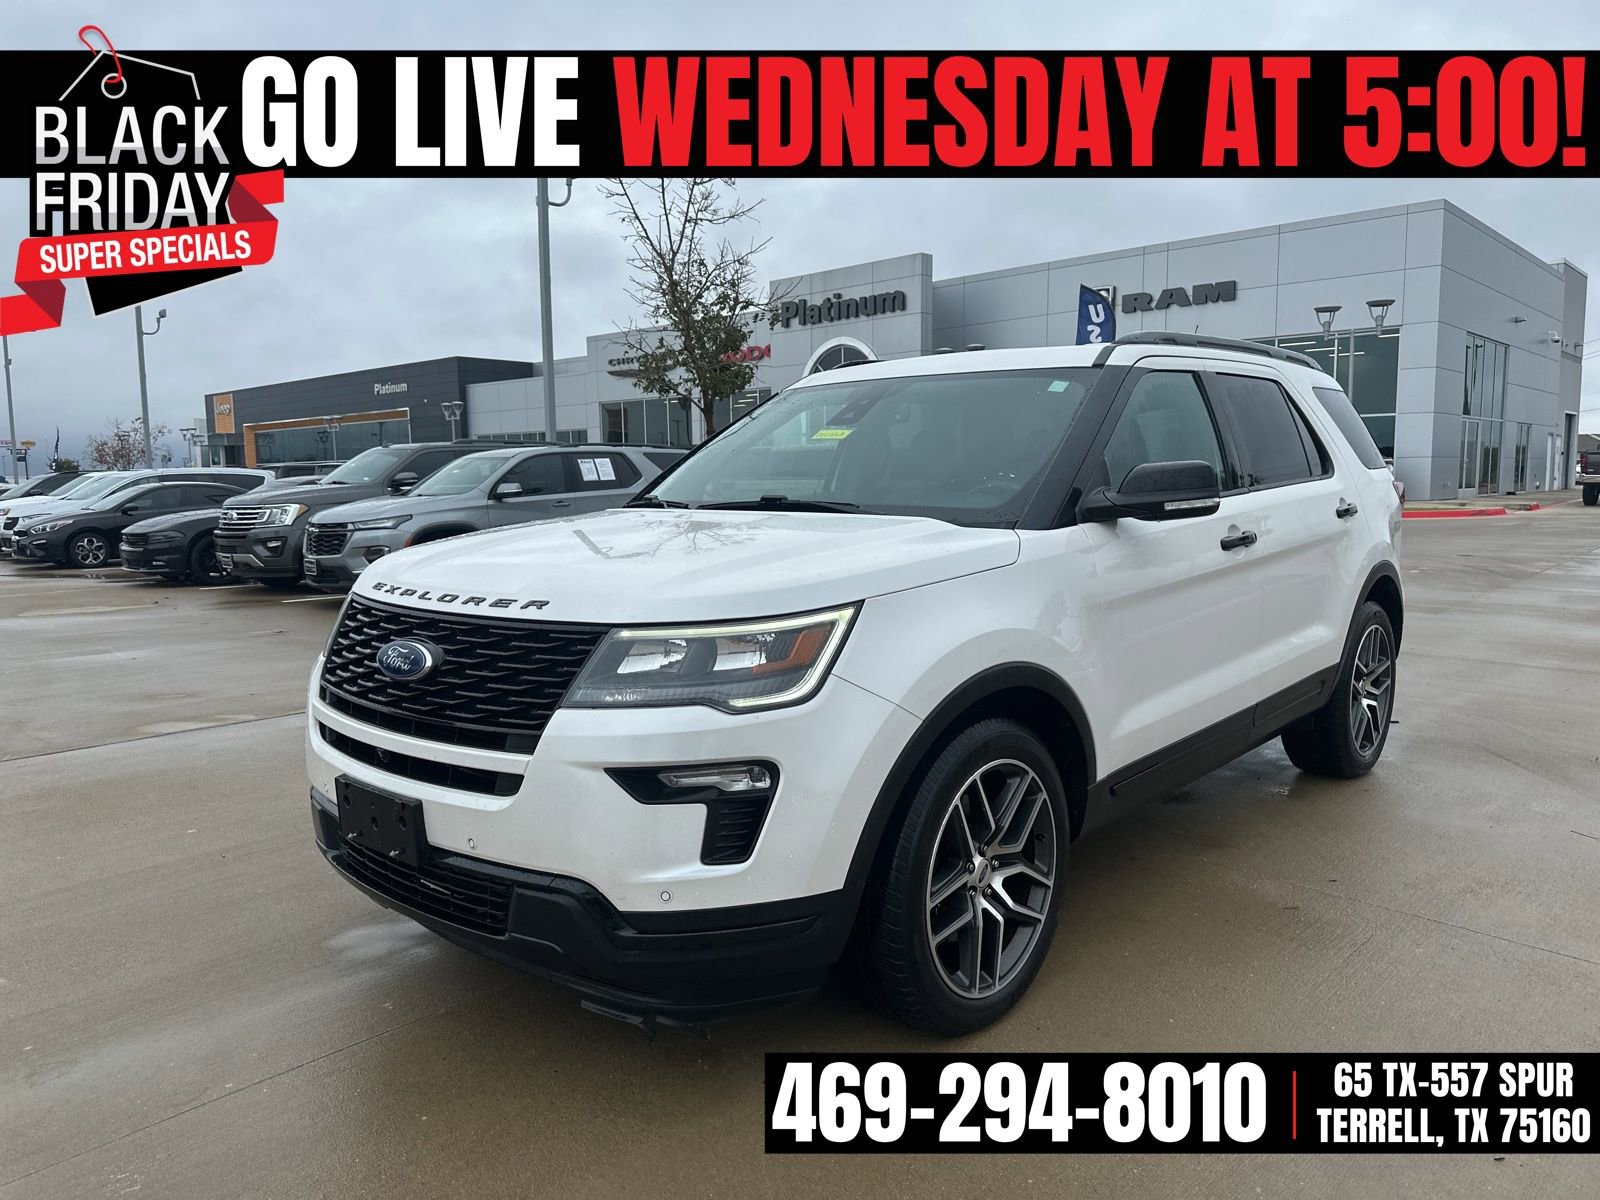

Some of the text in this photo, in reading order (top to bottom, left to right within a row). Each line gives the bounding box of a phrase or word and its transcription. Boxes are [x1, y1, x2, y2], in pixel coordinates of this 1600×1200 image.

[780, 290, 906, 328] Platinum
[1121, 280, 1236, 313] RAM
[374, 381, 408, 395] Platinum
[371, 581, 551, 610] EXPLORER
[383, 646, 415, 671] Ford
